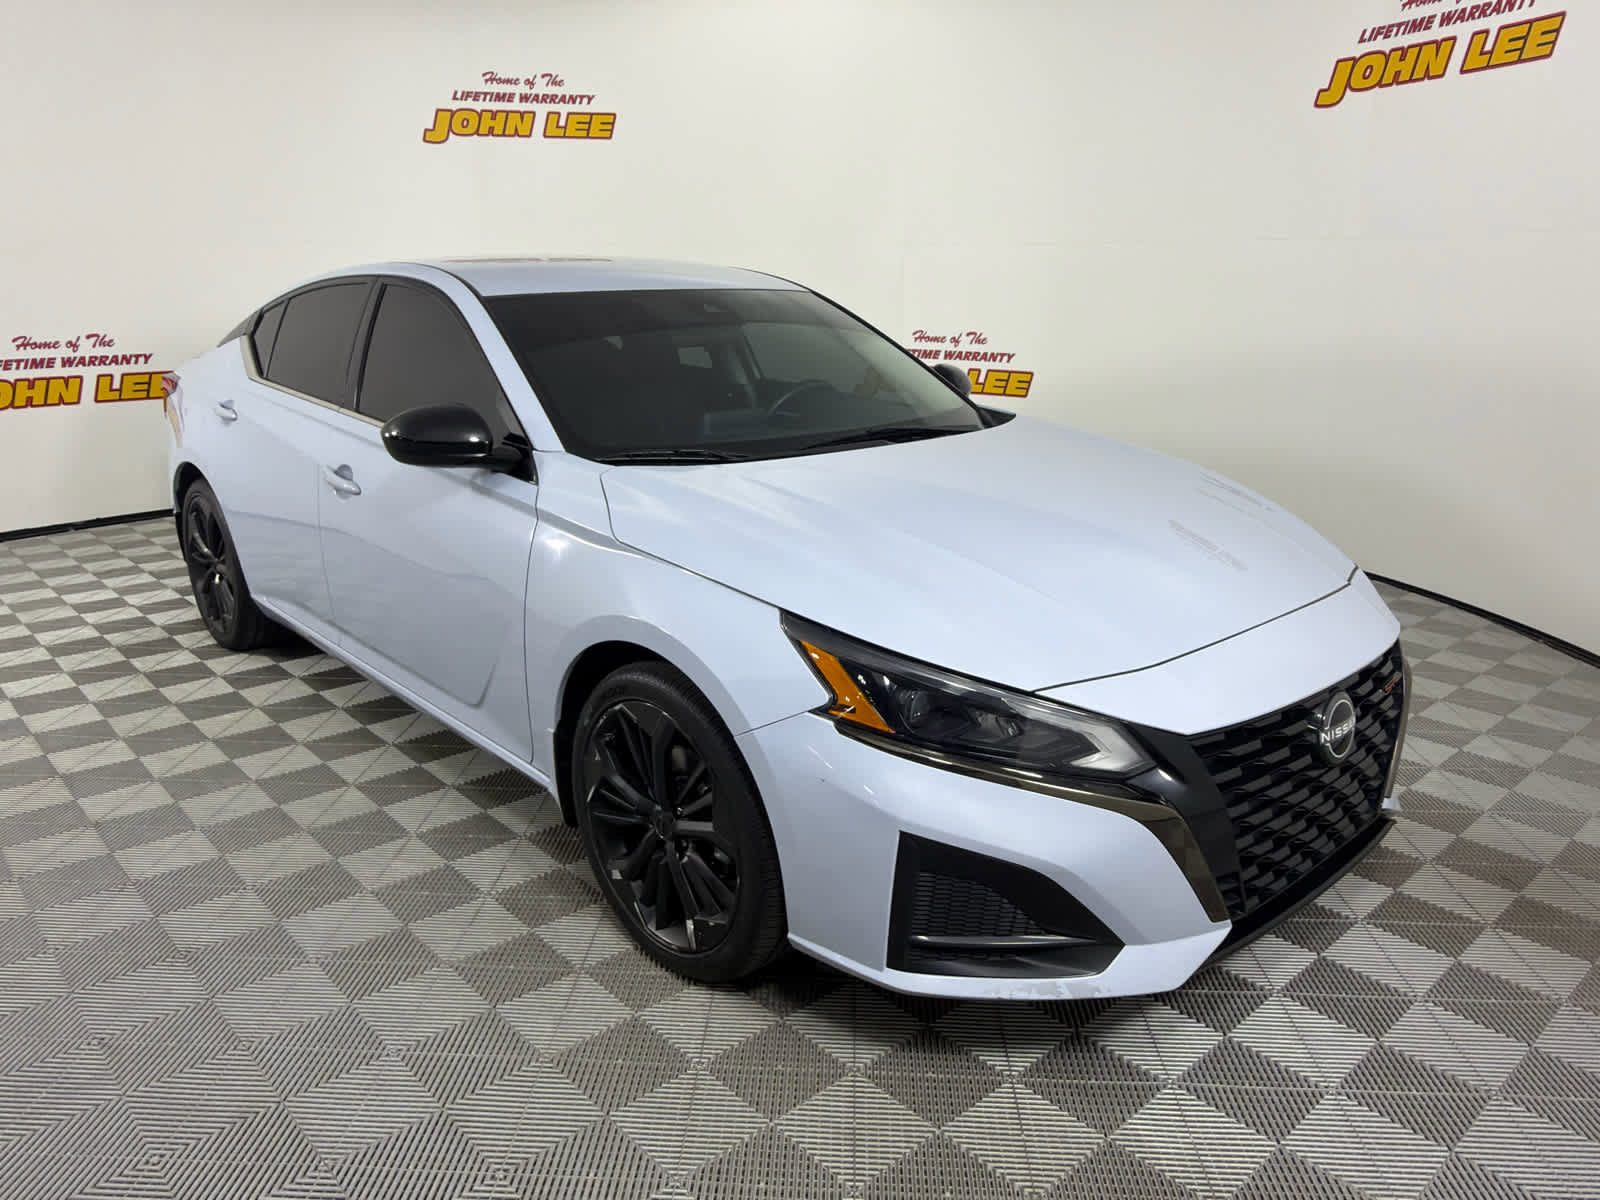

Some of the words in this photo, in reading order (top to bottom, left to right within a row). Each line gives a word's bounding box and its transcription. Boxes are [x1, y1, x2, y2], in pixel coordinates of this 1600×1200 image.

[1357, 14, 1437, 44] LIFETIME
[1314, 36, 1457, 108] JOHN
[1460, 11, 1567, 74] LEE
[482, 71, 520, 86] Home
[524, 75, 537, 90] of
[541, 73, 565, 87] The
[452, 90, 515, 103] LIFETIME
[519, 93, 596, 105] WARRANTY
[423, 108, 536, 144] JOHN
[543, 111, 616, 139] LEE
[12, 335, 61, 351] Home
[65, 336, 80, 353] of
[85, 333, 115, 349] The
[912, 329, 946, 343] Home
[949, 333, 962, 347] of
[966, 331, 988, 345] The
[0, 357, 57, 371] ETIME
[60, 353, 153, 368] WARRANTY
[943, 350, 1015, 363] WARRANTY
[967, 368, 1034, 398] LEE
